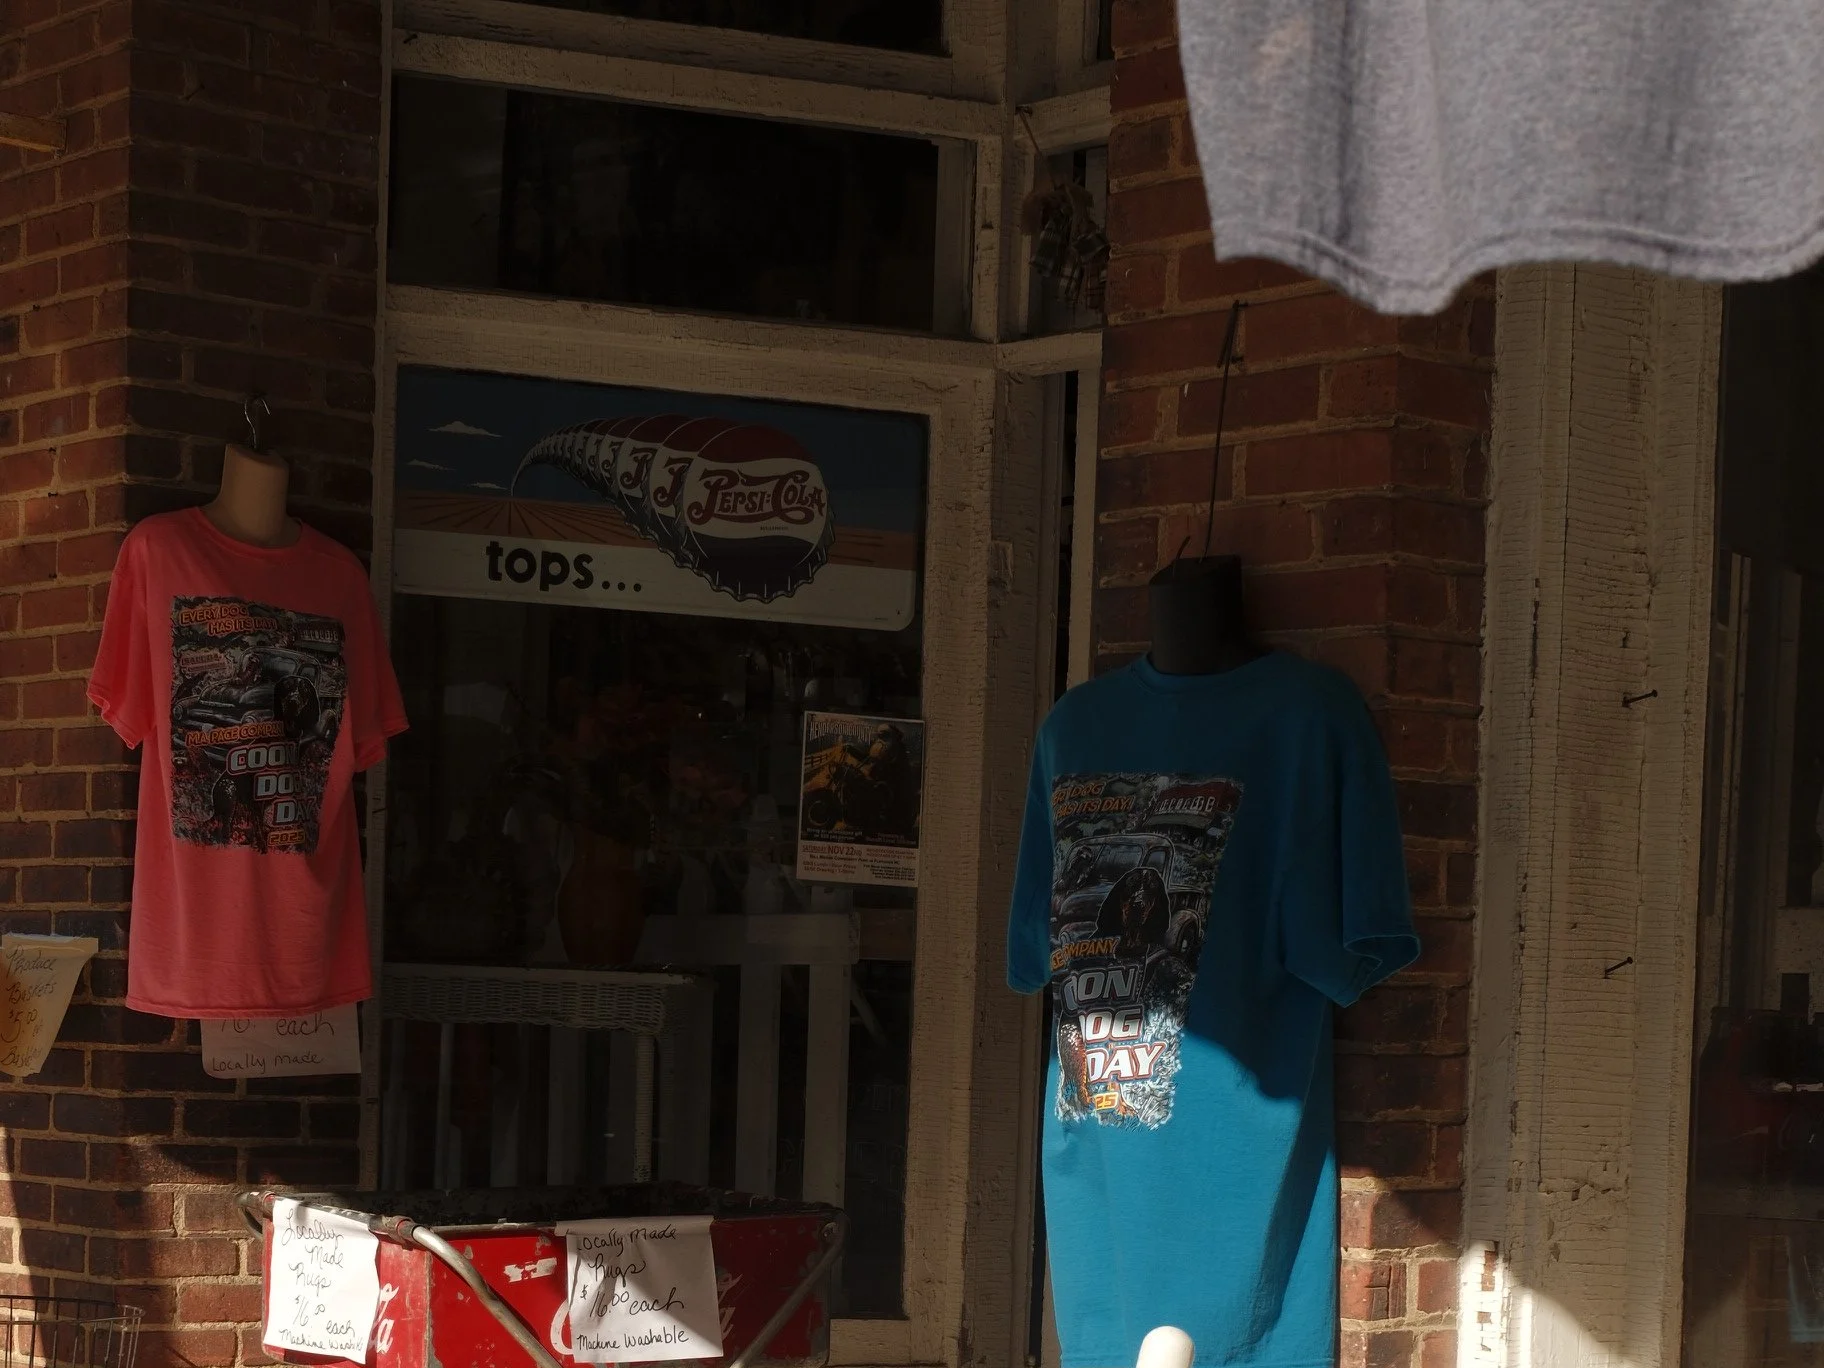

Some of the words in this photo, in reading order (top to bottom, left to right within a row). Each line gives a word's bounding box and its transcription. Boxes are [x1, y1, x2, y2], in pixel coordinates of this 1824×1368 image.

[181, 606, 219, 624] EVERY
[208, 619, 232, 635] HAS
[233, 618, 253, 633] ITS
[209, 725, 240, 742] PACE
[1101, 796, 1134, 812] DAY!
[269, 830, 305, 845] 2025
[827, 845, 844, 855] NOV
[275, 1010, 335, 1036] each
[212, 1052, 266, 1075] Locally
[1086, 1043, 1162, 1082] DAY
[1092, 1092, 1119, 1110] 25
[281, 1208, 344, 1249] Locally
[577, 1227, 624, 1258] ocally
[305, 1243, 344, 1270] Made
[287, 1261, 332, 1298] Rugs
[587, 1252, 647, 1289] Rugs
[629, 1286, 685, 1316] each
[325, 1319, 356, 1338] each
[623, 1324, 690, 1348] Washable
